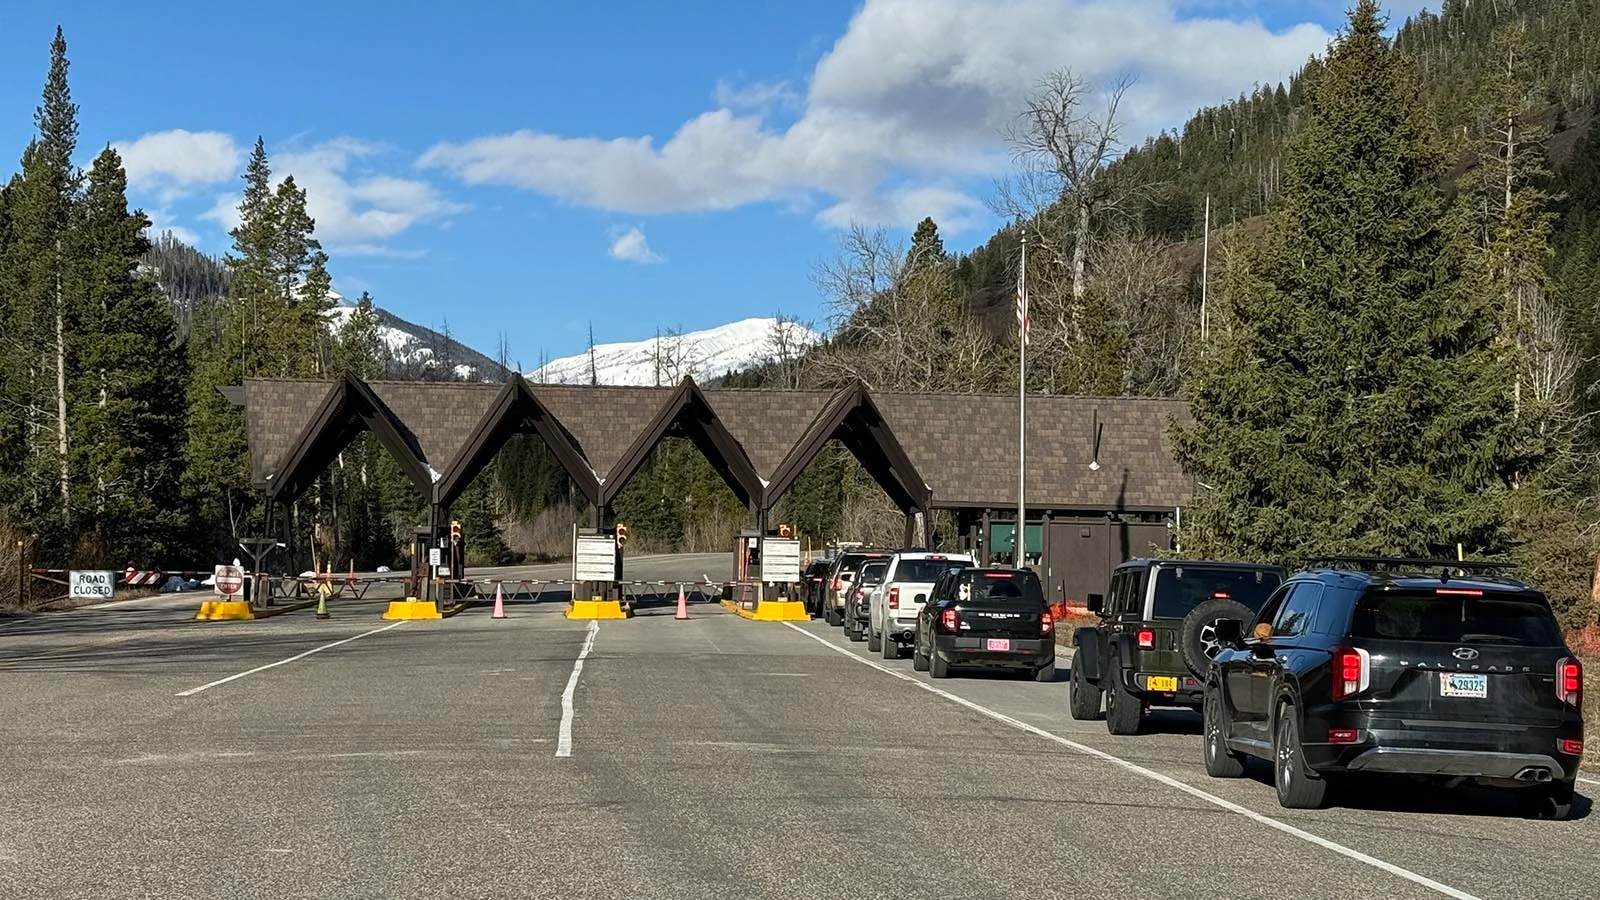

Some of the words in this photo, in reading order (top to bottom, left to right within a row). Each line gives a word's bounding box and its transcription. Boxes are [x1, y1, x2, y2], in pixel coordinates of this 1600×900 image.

[79, 575, 106, 584] ROAD
[73, 586, 111, 595] CLOSED
[1458, 679, 1485, 692] 29325
